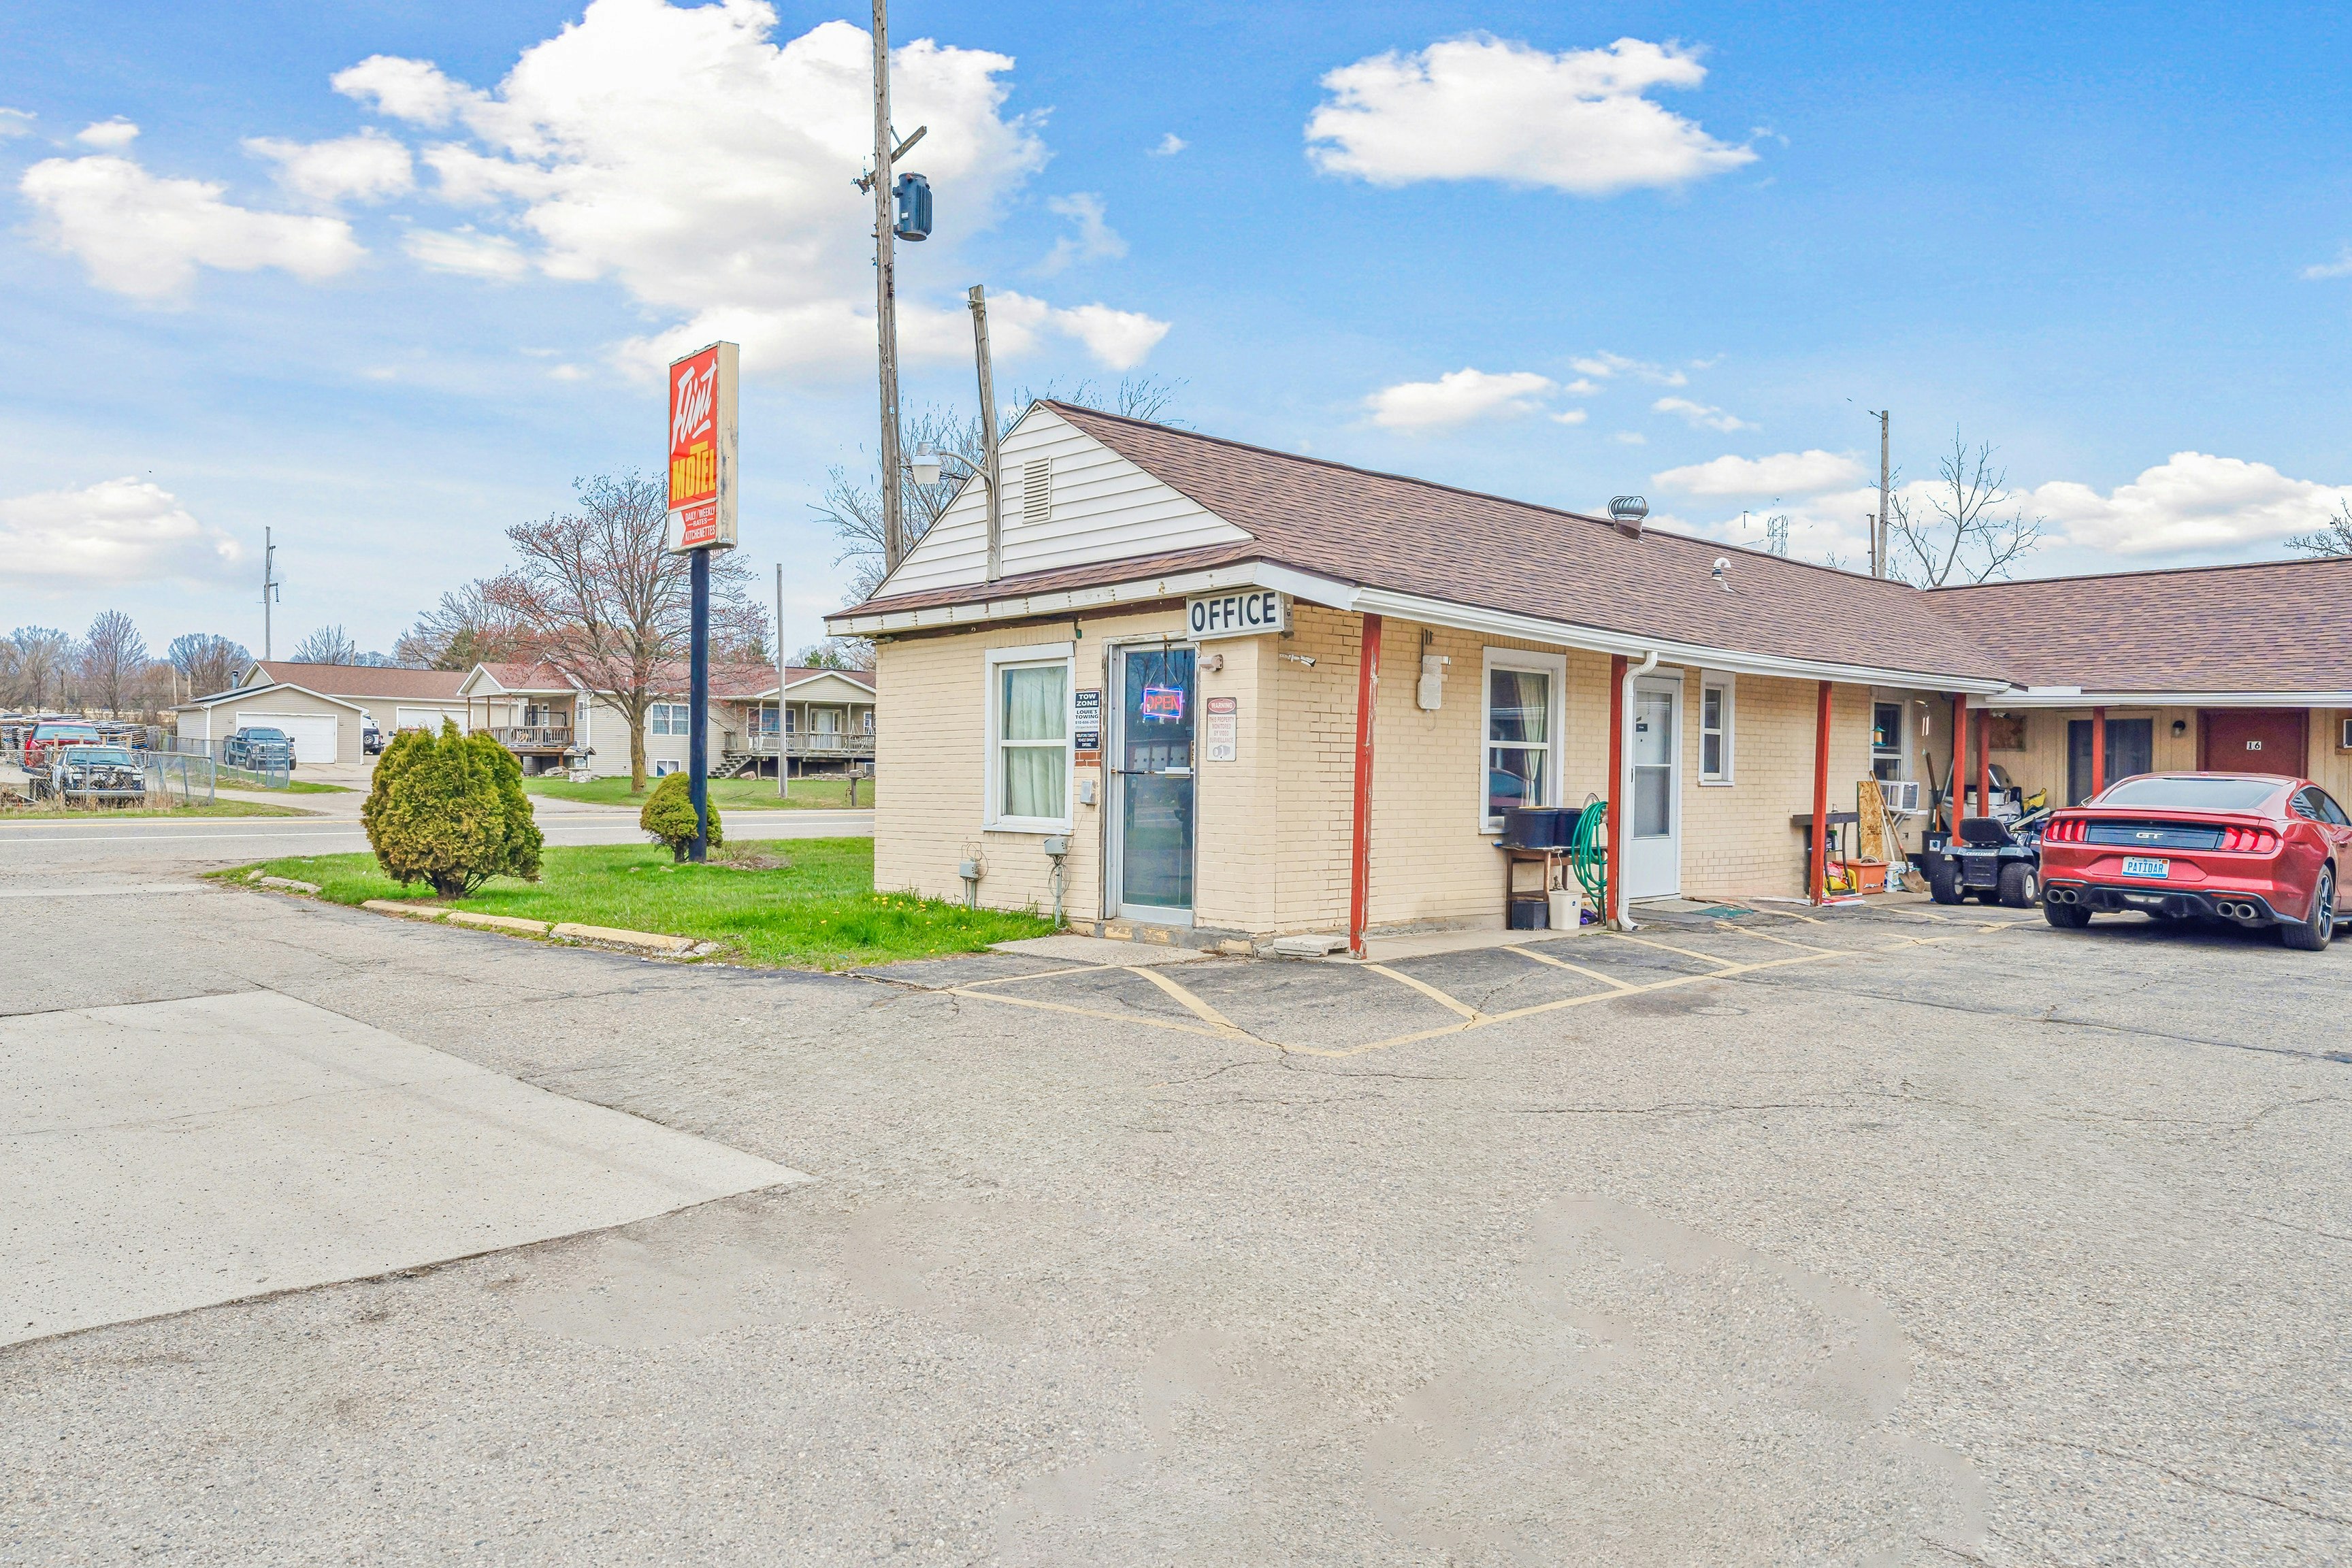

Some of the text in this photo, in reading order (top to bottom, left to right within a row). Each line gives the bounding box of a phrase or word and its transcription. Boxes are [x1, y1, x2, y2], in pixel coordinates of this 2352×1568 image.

[670, 358, 717, 455] Flint
[671, 440, 715, 502] MOTEL
[685, 506, 716, 522] DAILY/WEEKLY
[693, 517, 708, 527] RATES
[685, 524, 715, 542] KITCHENETTES
[1192, 592, 1276, 632] OFFICE
[1146, 696, 1179, 710] OPEN
[2127, 862, 2163, 873] PATIDAR
